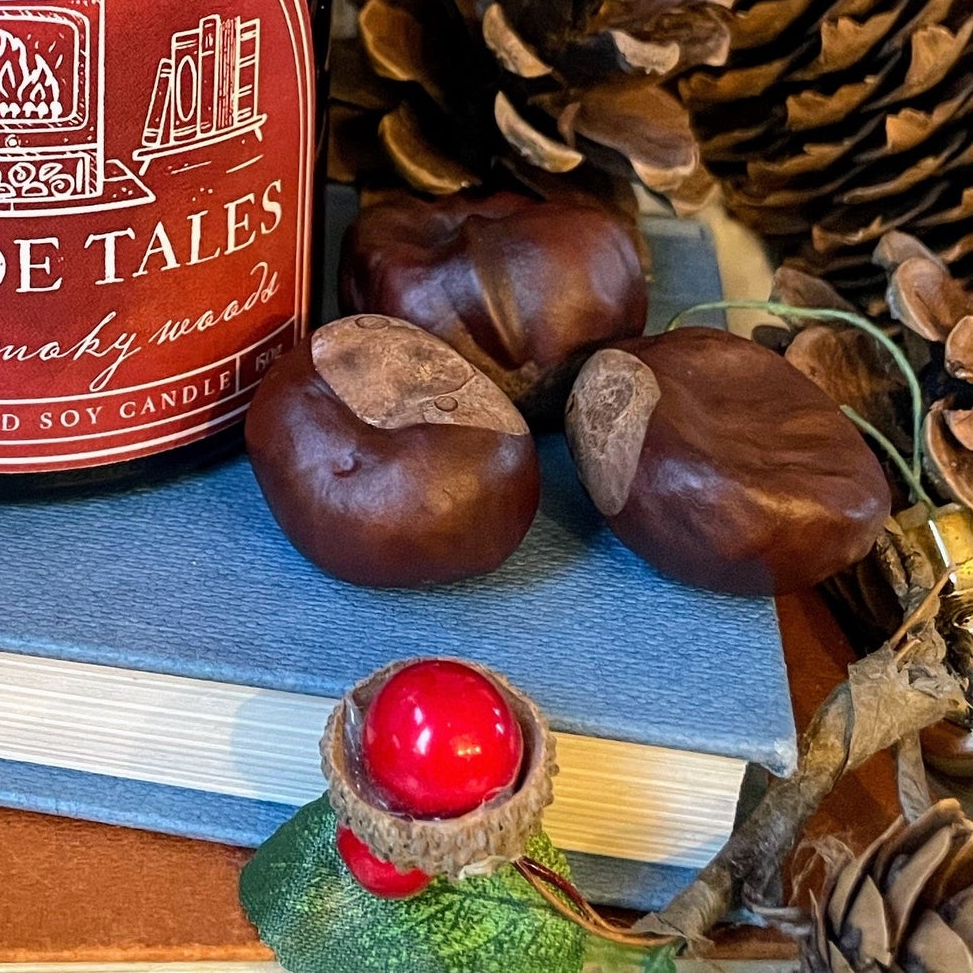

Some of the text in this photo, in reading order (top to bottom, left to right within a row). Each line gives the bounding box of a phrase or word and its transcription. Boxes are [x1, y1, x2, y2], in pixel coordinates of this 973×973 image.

[83, 179, 283, 286] TALES
[149, 261, 281, 346] woods
[39, 406, 103, 429] SOY
[118, 370, 232, 419] CANDLE
